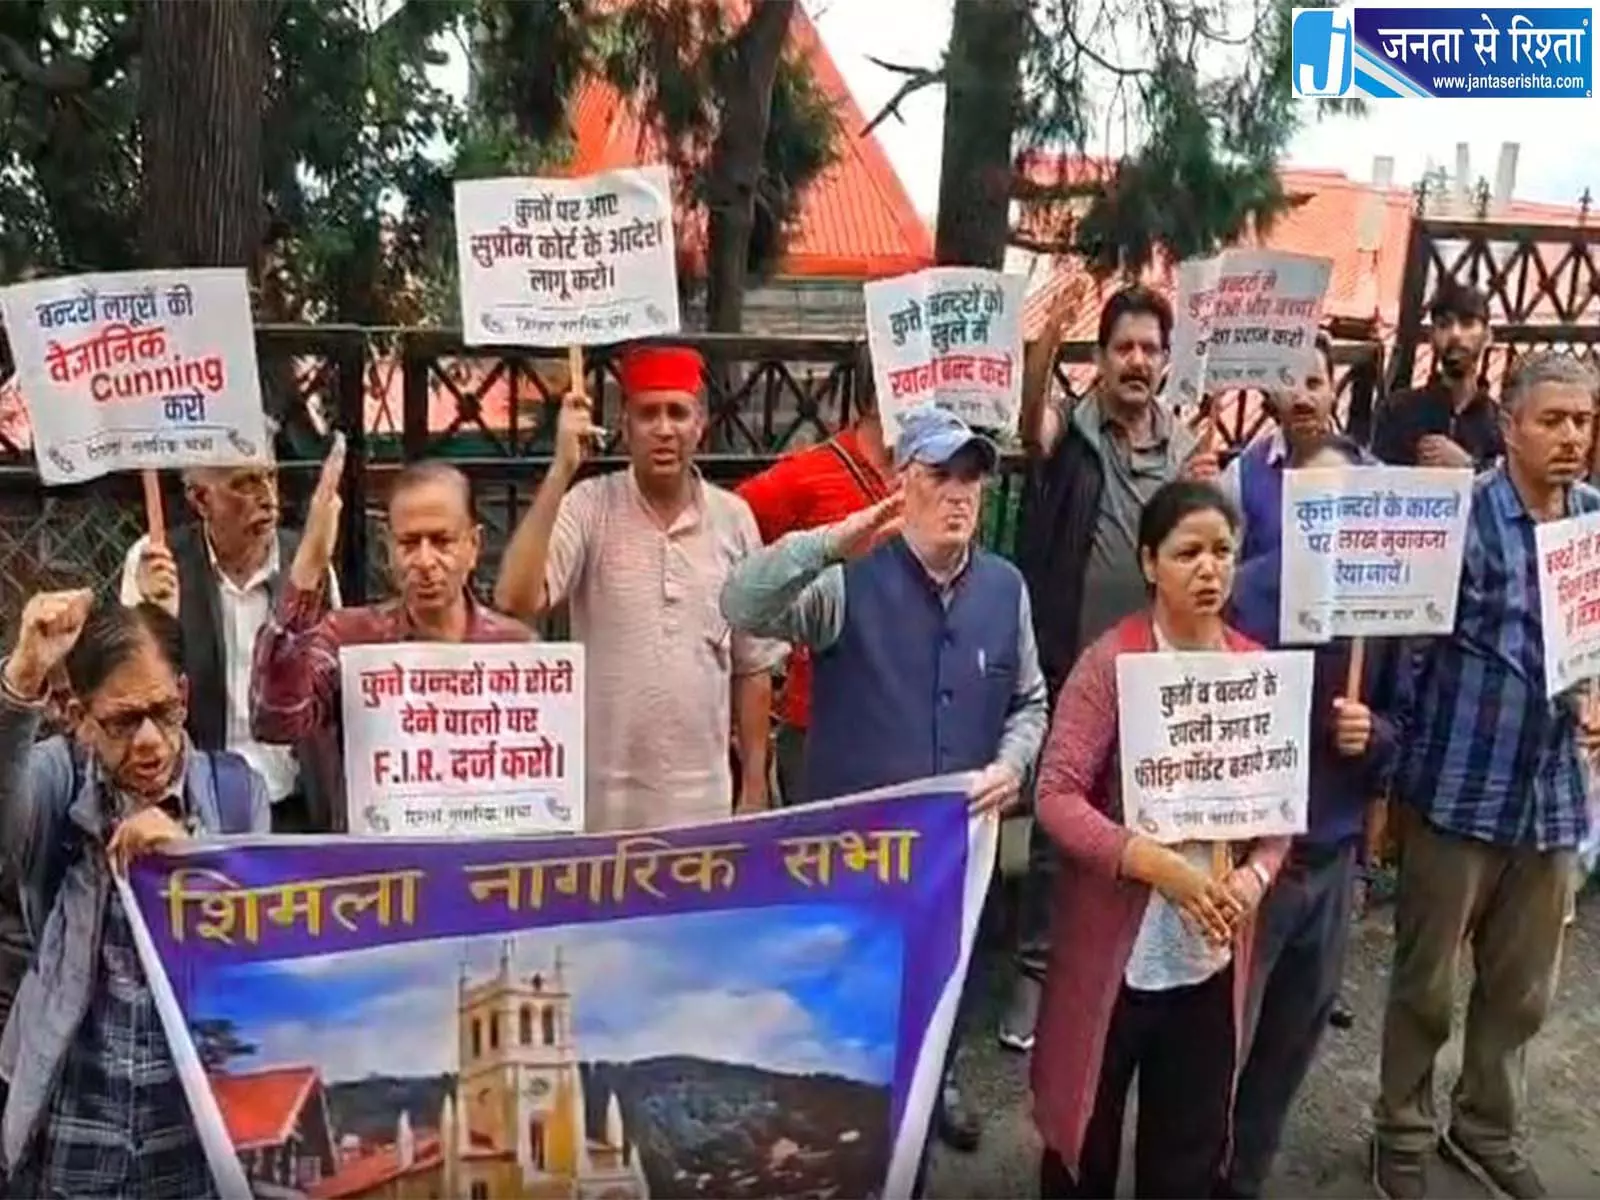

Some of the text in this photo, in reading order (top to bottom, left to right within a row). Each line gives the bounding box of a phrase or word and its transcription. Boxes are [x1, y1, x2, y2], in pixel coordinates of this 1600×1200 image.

[557, 198, 580, 222] पर
[583, 193, 619, 218] आए
[470, 226, 533, 268] सुप्रीम
[536, 227, 579, 260] कोर्ट
[582, 227, 602, 257] के
[164, 284, 194, 316] की
[528, 268, 570, 300] लागू
[90, 354, 223, 402] Cunning
[979, 355, 1013, 388] करो
[162, 387, 206, 421] करो
[1384, 491, 1402, 518] के
[1307, 533, 1331, 551] पर
[360, 659, 573, 708] कुत्ते बन्दरों को रोटी
[400, 702, 439, 734] देने
[506, 707, 538, 734] पर
[1167, 713, 1213, 746] खाली
[1253, 713, 1270, 735] पर
[374, 736, 565, 785] F.I.R. दर्ज करो।
[160, 828, 921, 945] शिमला नागरिक सभा
